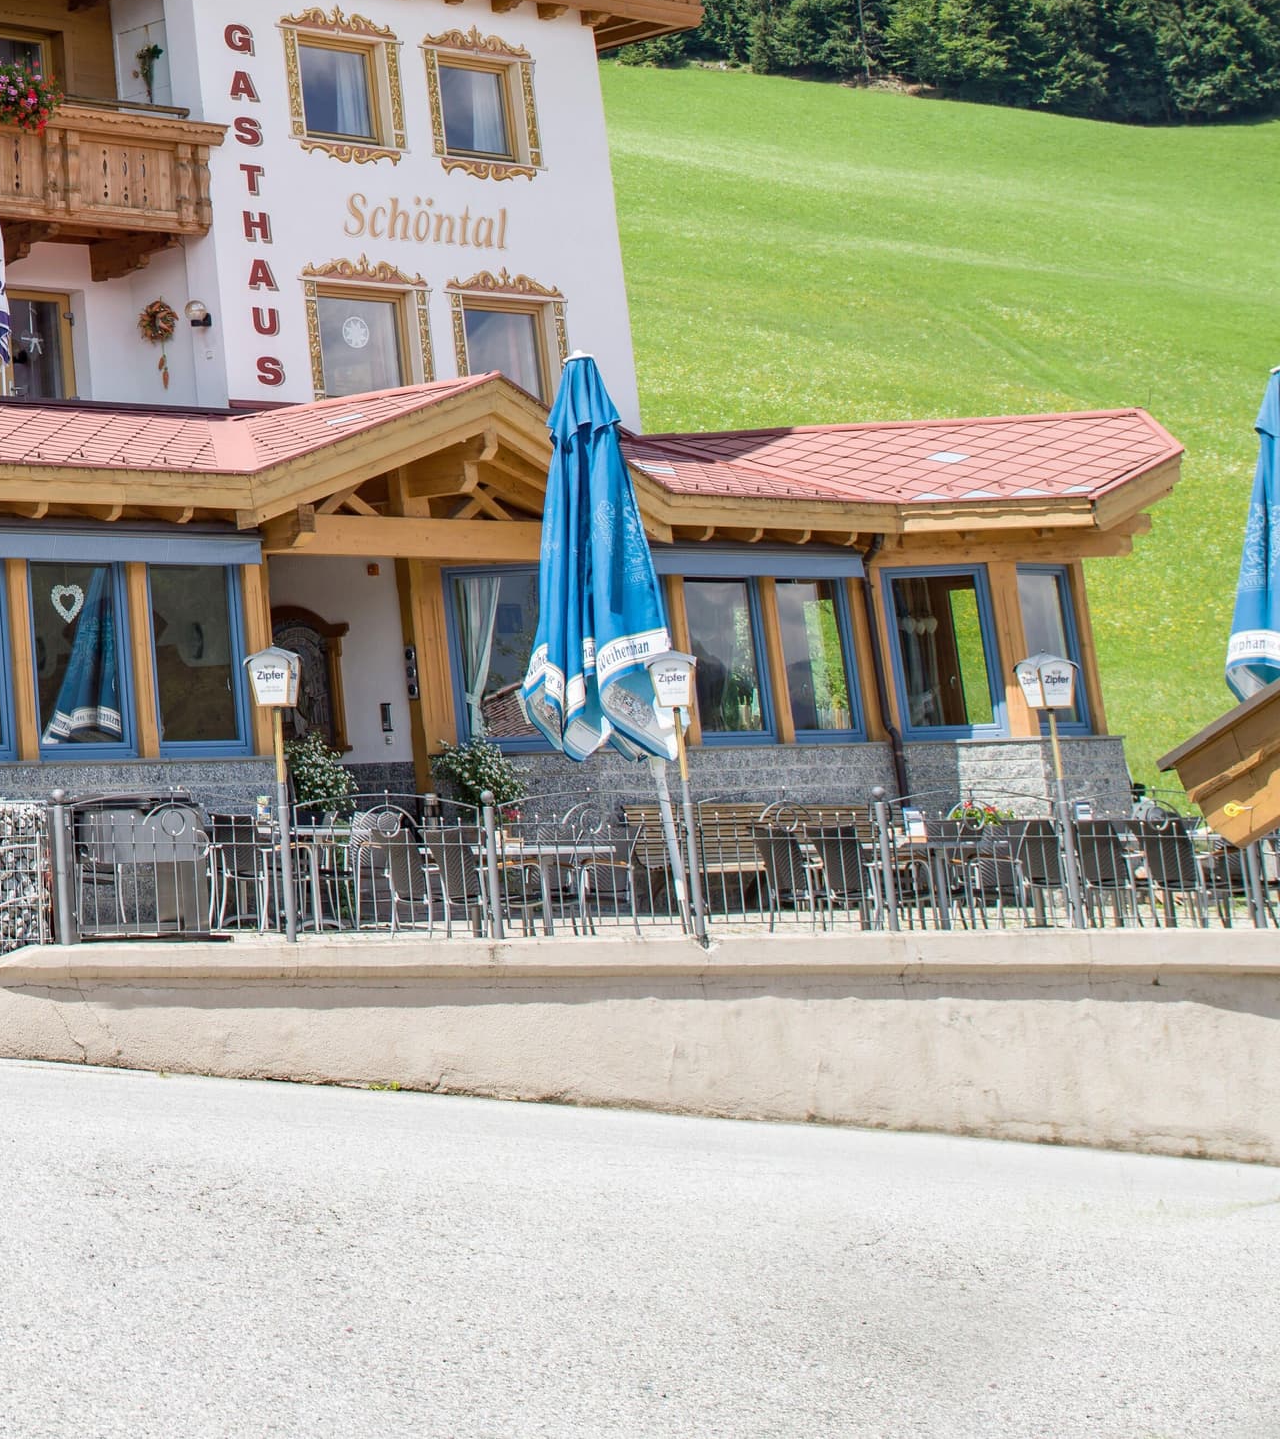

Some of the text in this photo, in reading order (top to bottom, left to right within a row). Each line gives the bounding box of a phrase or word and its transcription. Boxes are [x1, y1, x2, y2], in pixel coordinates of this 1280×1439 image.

[224, 23, 286, 387] GASTHAUS
[343, 192, 509, 250] Schöntal
[257, 670, 285, 682] Zipfer
[658, 673, 686, 685] Zipfer
[1044, 674, 1070, 686] Zipfer
